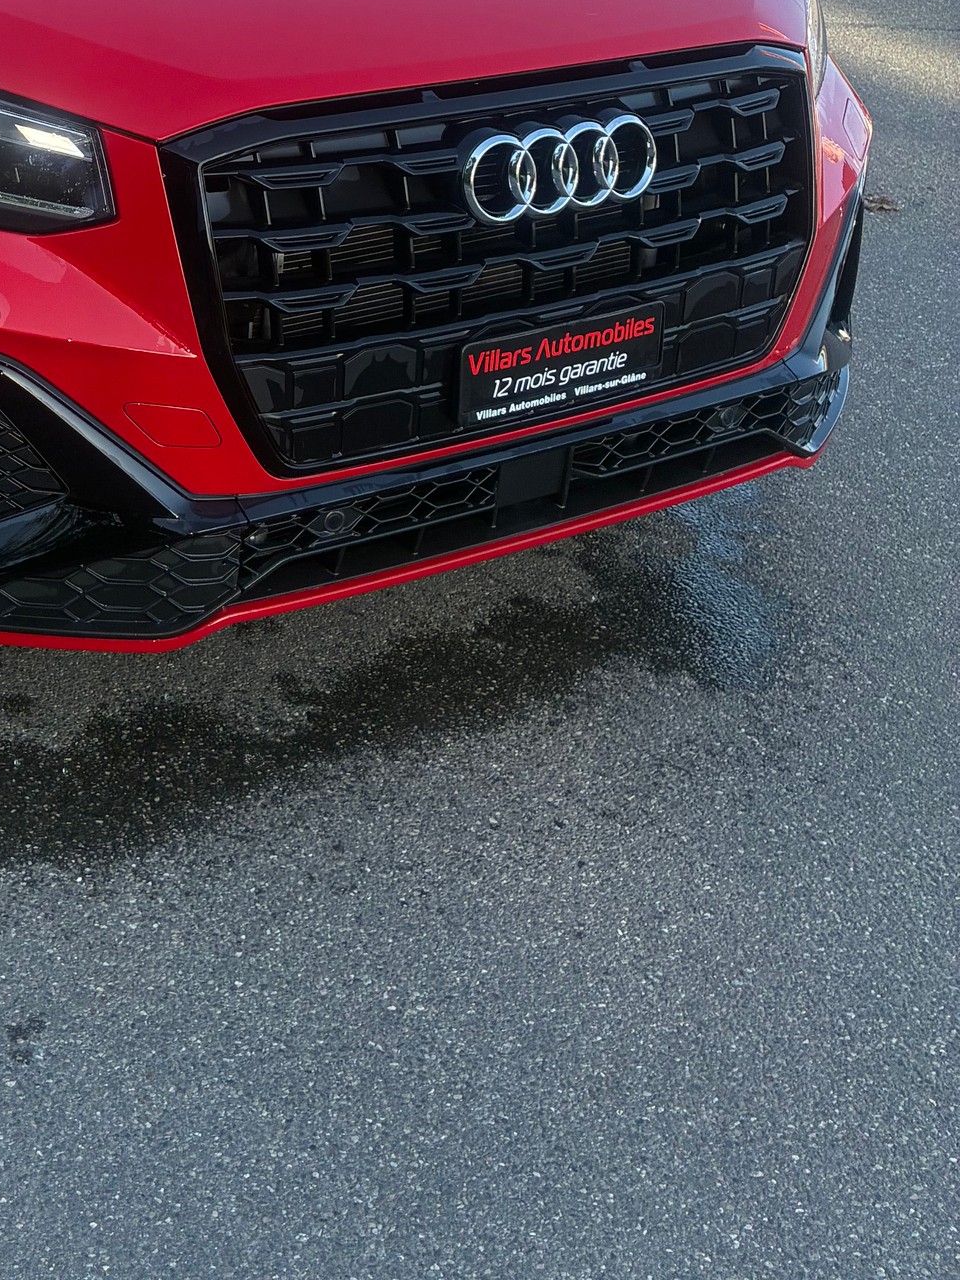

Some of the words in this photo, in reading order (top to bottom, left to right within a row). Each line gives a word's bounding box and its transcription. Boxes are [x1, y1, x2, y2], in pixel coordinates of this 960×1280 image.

[468, 346, 533, 376] Villars
[535, 317, 655, 362] Automobiles
[476, 405, 507, 421] Villars
[509, 391, 567, 413] Automobiles
[574, 371, 647, 397] Villars-sur-Glâne
[492, 377, 512, 398] 12
[514, 367, 556, 393] mois
[559, 350, 628, 386] garantie
